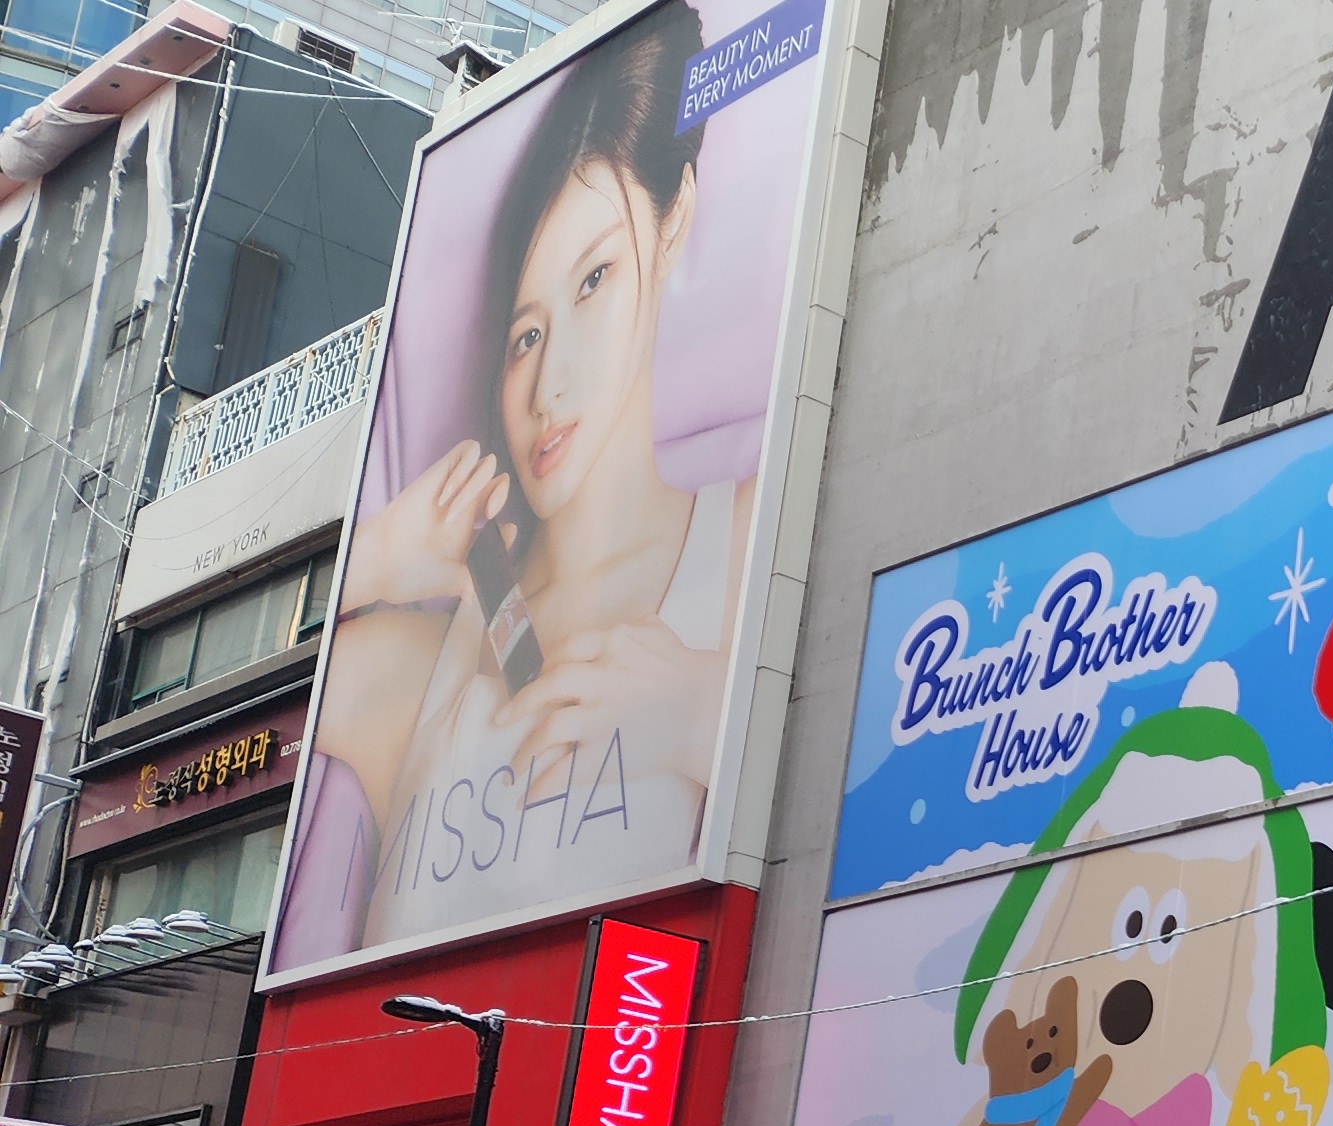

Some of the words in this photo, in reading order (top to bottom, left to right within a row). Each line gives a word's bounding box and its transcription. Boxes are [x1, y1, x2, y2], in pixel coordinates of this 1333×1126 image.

[683, 73, 731, 119] EVERY
[732, 24, 814, 91] MOMENT
[688, 34, 749, 90] BEAUTY
[751, 21, 771, 53] IN
[193, 543, 225, 573] NEW
[233, 522, 271, 555] YORK
[900, 612, 1040, 732] Brunch
[1038, 570, 1206, 692] Brother
[195, 728, 270, 792] 성형외과
[972, 704, 1090, 790] House
[340, 727, 629, 912] MISSHA
